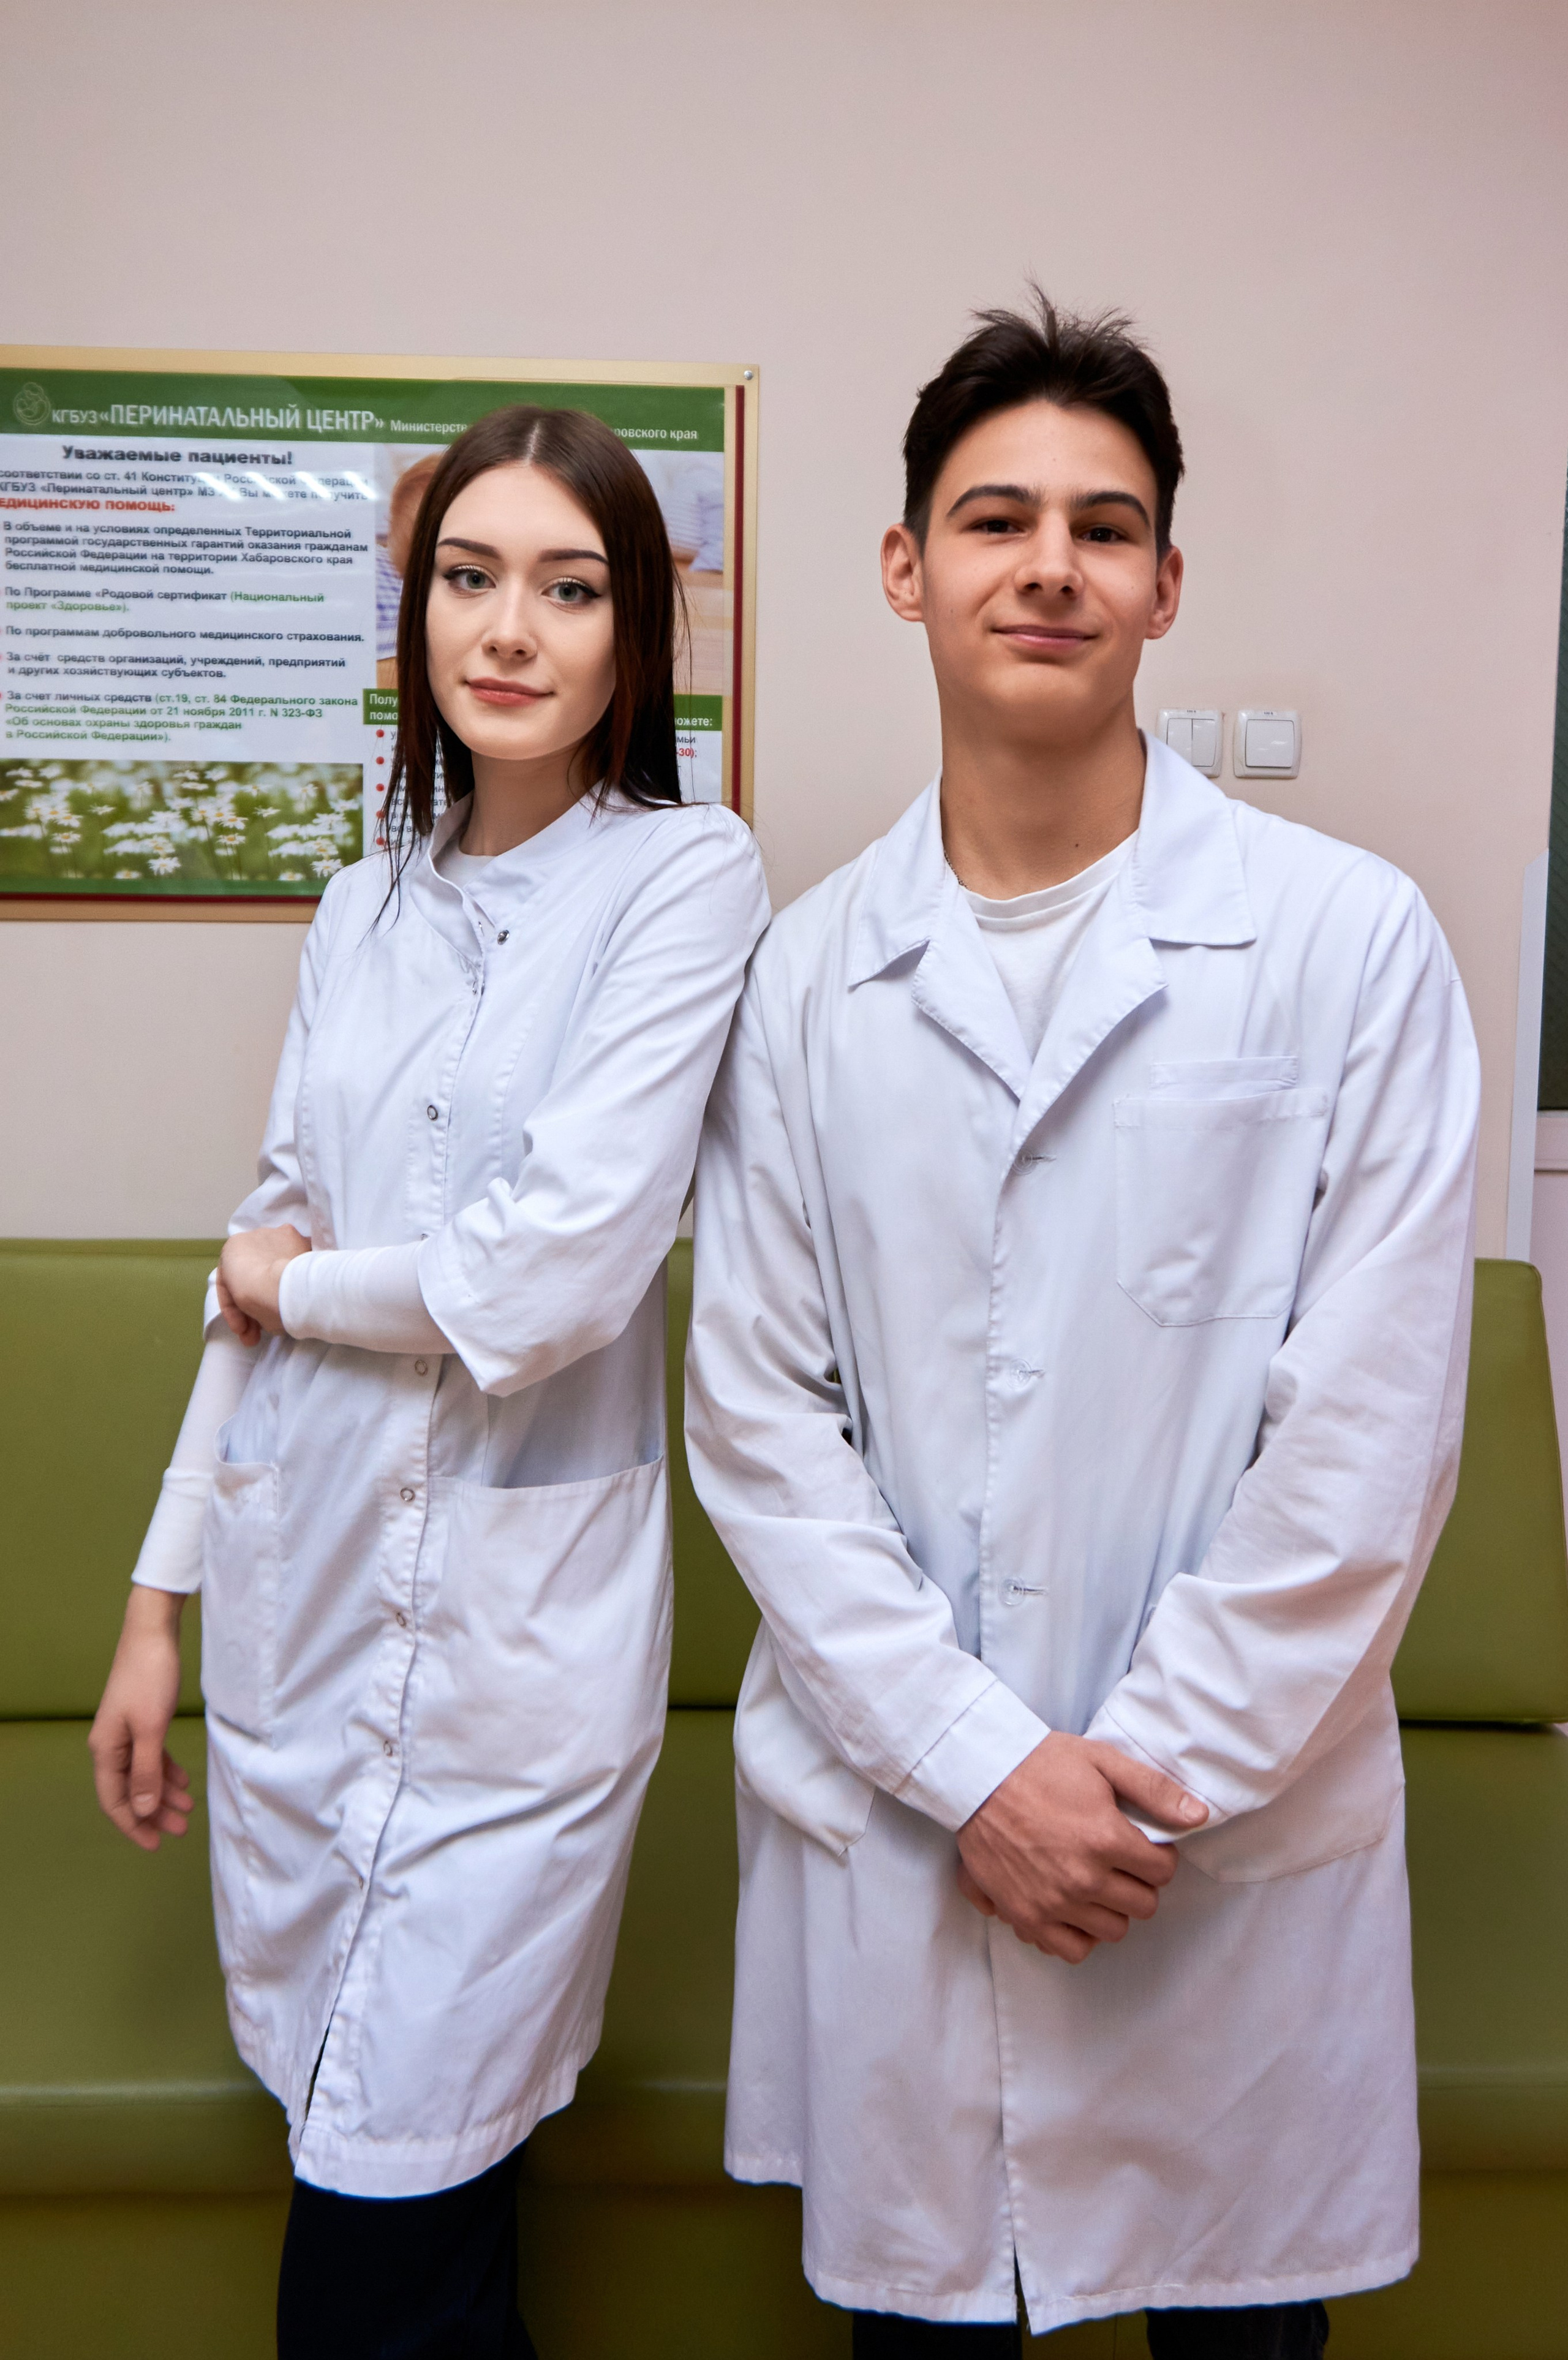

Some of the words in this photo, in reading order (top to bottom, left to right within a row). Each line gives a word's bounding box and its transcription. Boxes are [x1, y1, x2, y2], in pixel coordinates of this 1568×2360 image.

[52, 409, 98, 423] КГБУЗ
[100, 403, 300, 429] «ПЕРИНАТАЛЬНЫЙ
[307, 409, 384, 433] ЦЕНТР»
[390, 419, 468, 434] Министерств
[613, 428, 667, 439] ровского
[671, 429, 698, 441] края
[62, 445, 181, 462] Уважаемые
[189, 451, 292, 465] пациенты!
[124, 472, 137, 480] 41
[40, 482, 147, 495] «Перинатальный
[151, 488, 193, 498] центр»
[0, 497, 100, 510] ЕДИЦИНСКУЮ
[105, 500, 175, 512] ПОМОЩЬ:
[3, 521, 12, 531] В
[15, 522, 61, 532] объеме
[93, 525, 149, 534] условиях
[153, 526, 241, 536] определенных
[245, 527, 351, 539] Территориальной
[5, 535, 78, 547] программой
[82, 538, 187, 548] государственных
[191, 539, 244, 549] гарантий
[305, 543, 368, 552] гражданам
[5, 547, 77, 558] Российской
[80, 549, 147, 560] Федерации
[168, 552, 237, 562] территории
[241, 552, 323, 564] Хабаровского
[326, 556, 353, 564] края
[6, 561, 76, 570] бесплатной
[80, 563, 159, 573] медицинской
[163, 566, 214, 575] помощи.
[5, 586, 20, 596] По
[24, 587, 91, 598] Программе
[95, 588, 153, 599] «Родовой
[157, 591, 227, 602] сертификат
[230, 591, 324, 603] (Национальный
[6, 601, 47, 611] проект
[6, 626, 21, 635] По
[25, 628, 99, 638] программам
[102, 627, 195, 638] добровольного
[200, 631, 283, 641] медицинского
[287, 633, 364, 643] страхования.
[6, 652, 20, 661] За
[57, 654, 105, 664] средств
[108, 654, 186, 665] организаций,
[190, 656, 265, 666] учреждений,
[268, 657, 345, 668] предприятий
[18, 667, 59, 676] других
[63, 667, 158, 678] хозяйствующих
[161, 668, 226, 679] субъектов.
[7, 690, 21, 700] За
[104, 694, 152, 703] средств
[230, 694, 315, 705] Федерального
[370, 694, 398, 708] Полу
[6, 703, 76, 714] Российской
[80, 705, 146, 716] Федерации
[167, 706, 179, 715] 21
[183, 707, 225, 717] ноября
[229, 708, 254, 716] 2011
[282, 709, 323, 717] 323-ФЗ
[6, 716, 29, 725] «Об
[85, 720, 130, 728] охраны
[134, 720, 190, 729] здоровья
[194, 721, 242, 730] граждан
[370, 712, 398, 720] помо
[675, 717, 713, 726] ожете:
[17, 730, 88, 739] Российской
